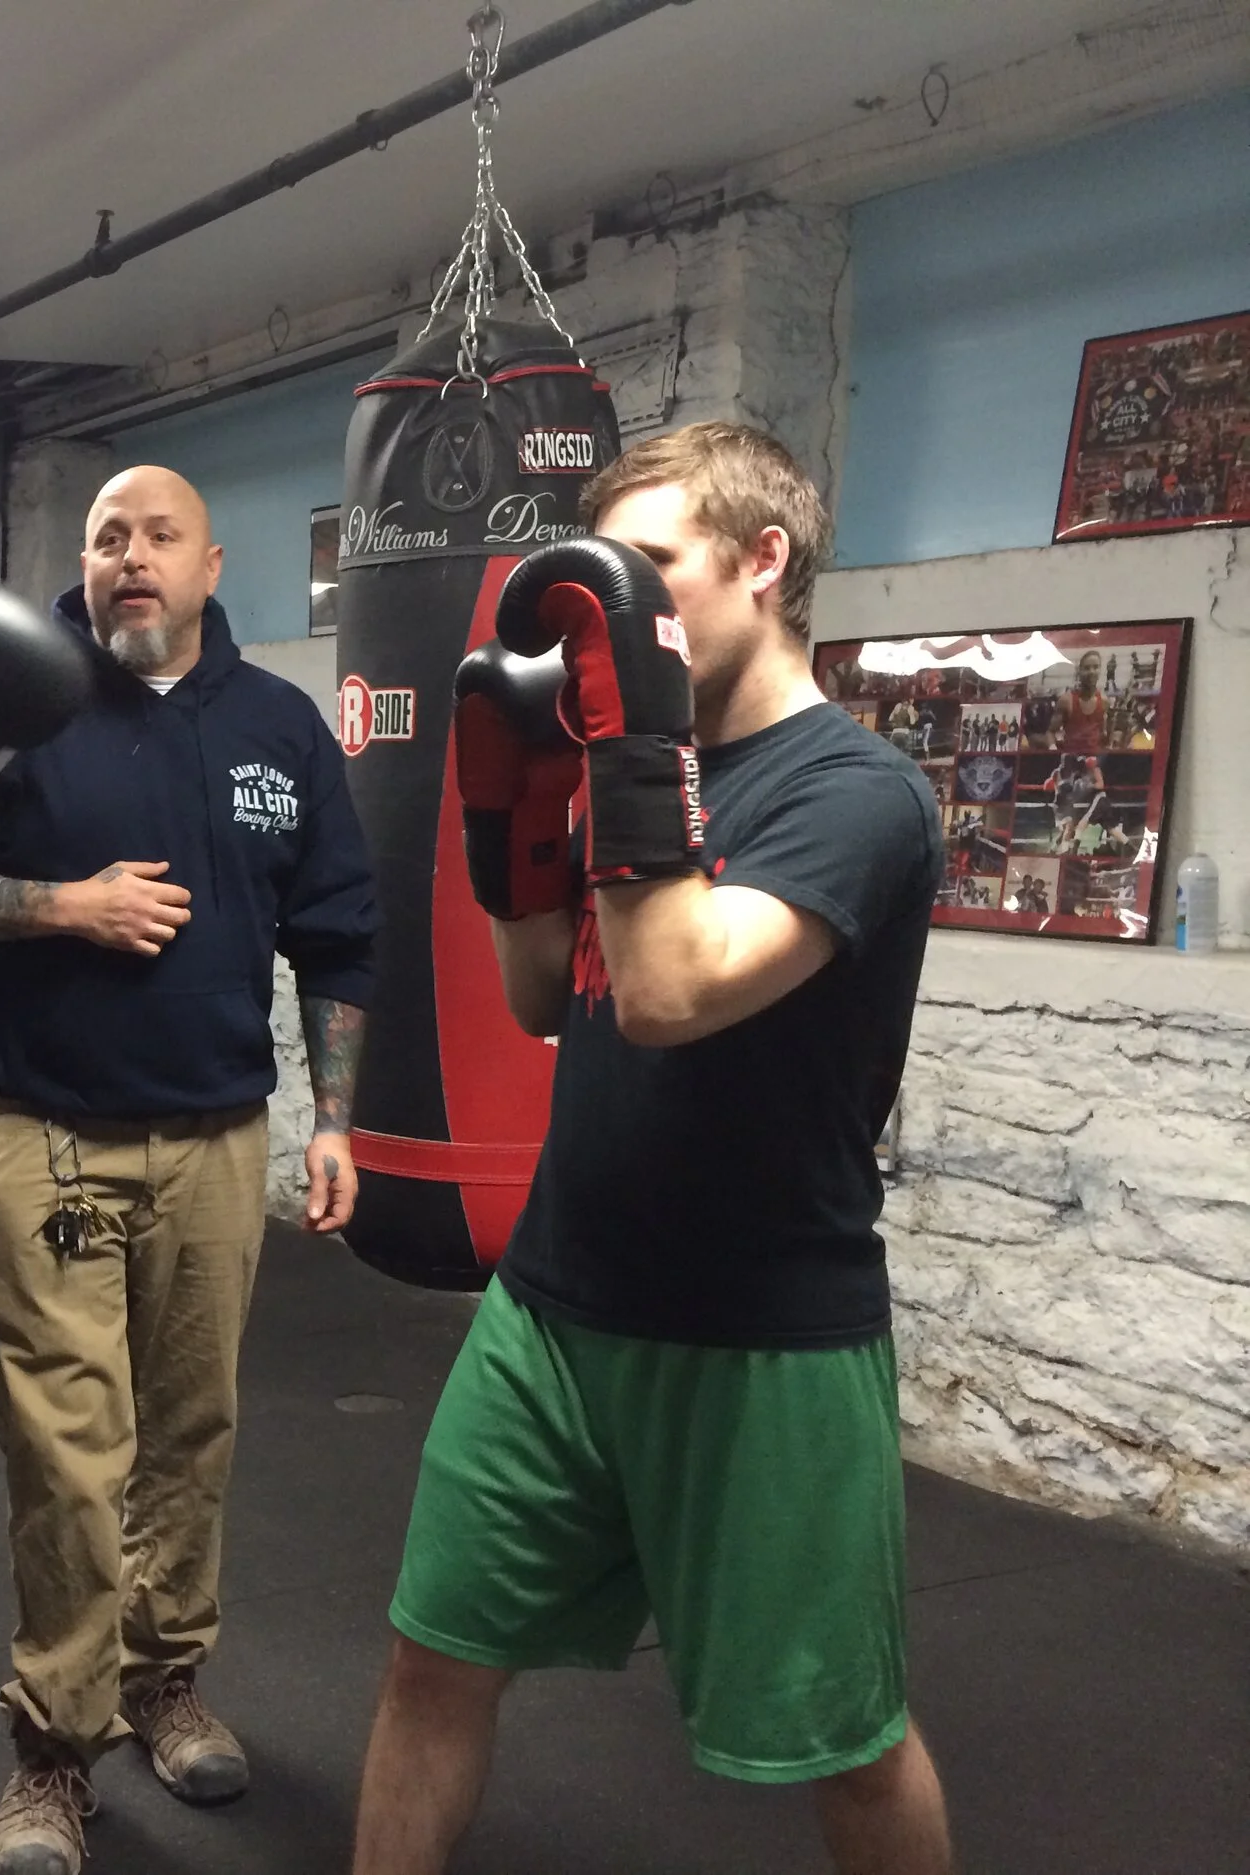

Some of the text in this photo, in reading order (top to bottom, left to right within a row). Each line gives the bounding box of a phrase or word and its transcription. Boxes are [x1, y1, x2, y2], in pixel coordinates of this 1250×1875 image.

[524, 432, 595, 468] RINGSID
[348, 500, 448, 555] Williams
[343, 685, 411, 746] R SIDE
[229, 763, 295, 792] SAINT LOUIS
[233, 786, 298, 817] ALL CITY
[233, 808, 299, 832] Boxing Club
